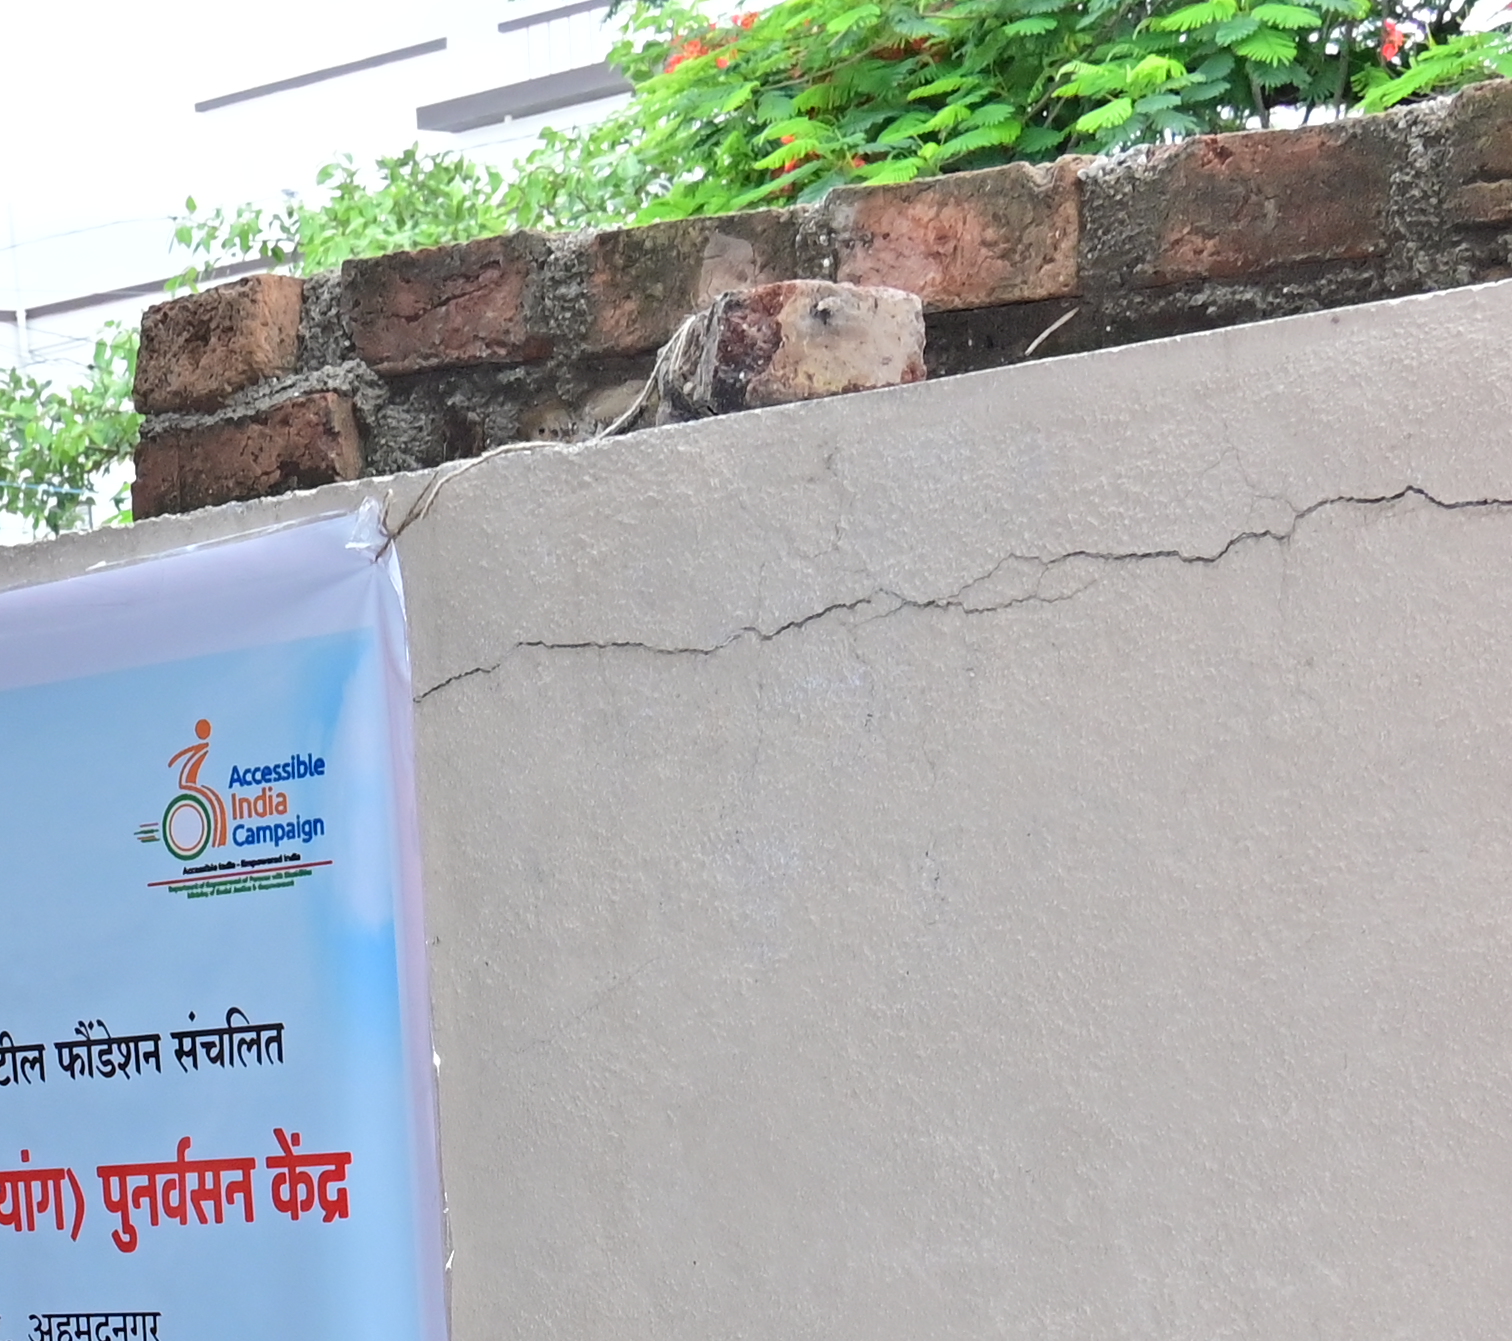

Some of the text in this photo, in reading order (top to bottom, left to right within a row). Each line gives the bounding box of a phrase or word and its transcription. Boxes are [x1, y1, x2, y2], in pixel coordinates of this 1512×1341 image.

[228, 753, 325, 789] Accessible
[231, 786, 288, 820] India
[232, 815, 325, 847] Campaign
[55, 1019, 161, 1080] फौंडेशन
[170, 1006, 284, 1073] संचलित
[96, 1136, 256, 1253] पुनर्वसन
[265, 1127, 352, 1225] केंद्र
